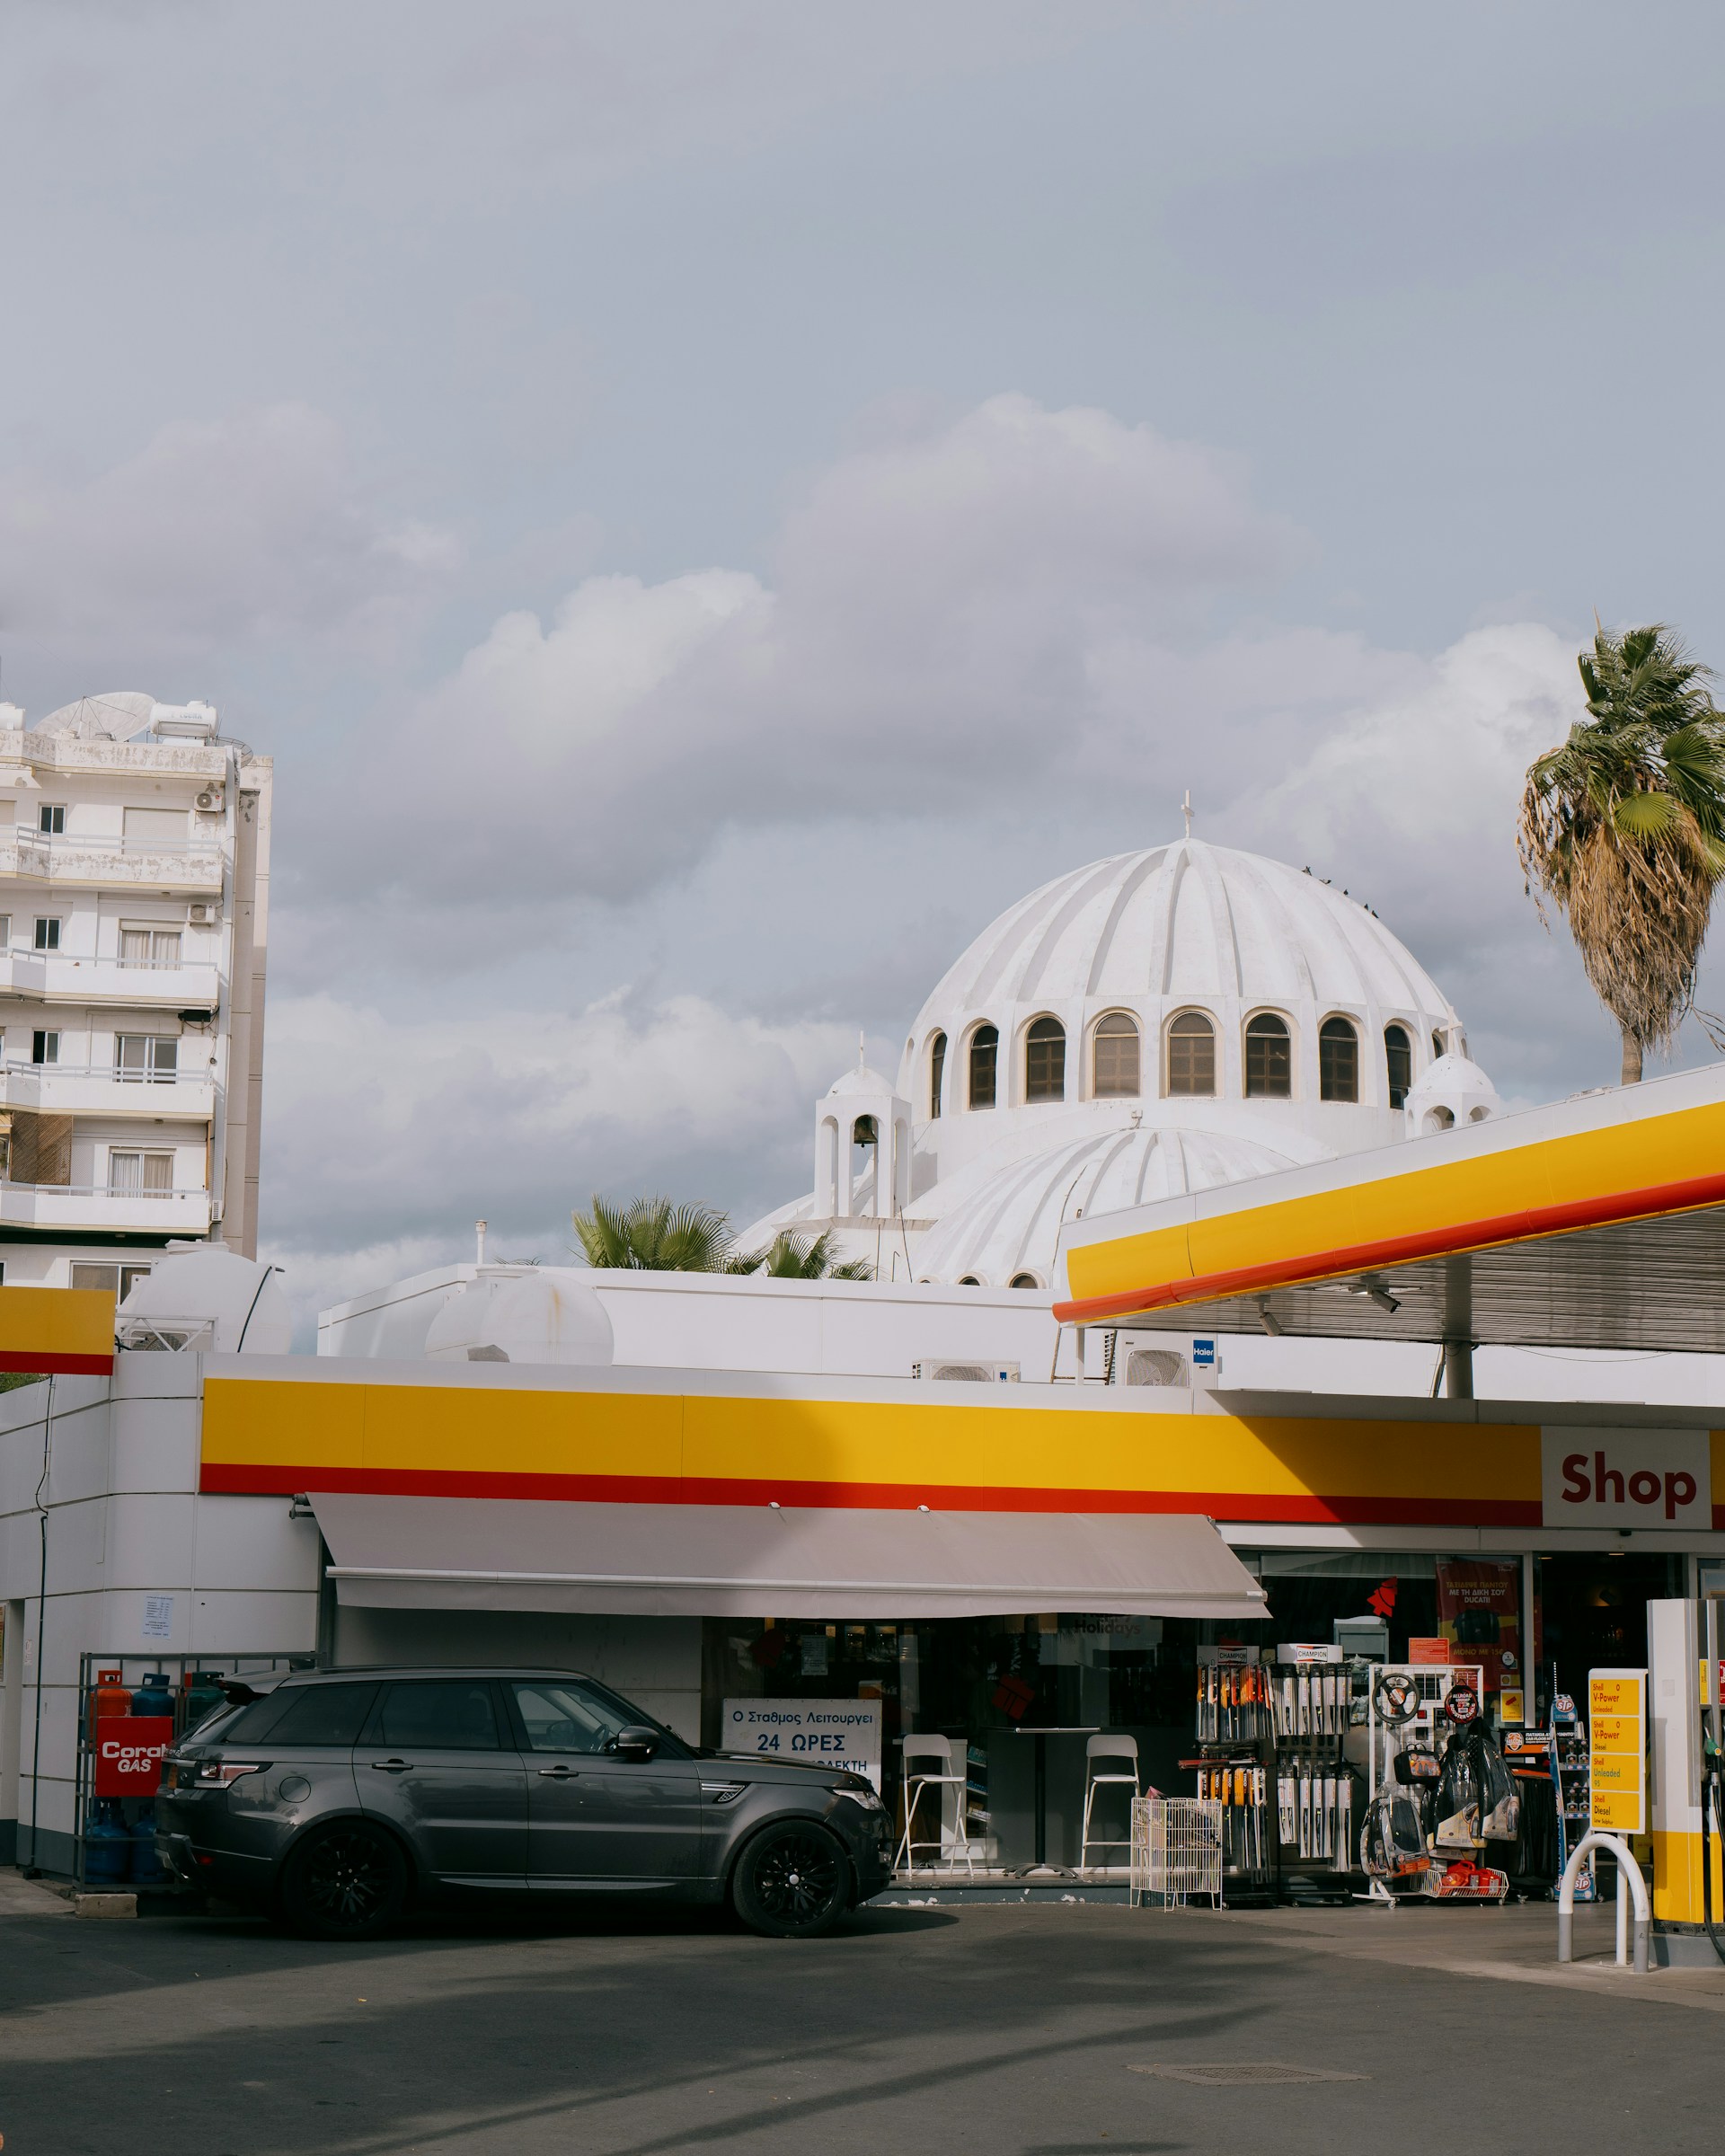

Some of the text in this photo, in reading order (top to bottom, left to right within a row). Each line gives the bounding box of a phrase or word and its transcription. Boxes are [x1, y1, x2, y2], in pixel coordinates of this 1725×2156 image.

[1193, 1348, 1213, 1356] Haier
[1561, 1451, 1697, 1520] Shop
[1075, 1619, 1141, 1639] Holidays
[1593, 1692, 1619, 1702] V-Power
[1558, 1700, 1572, 1710] STP
[733, 1710, 872, 1725] Ο Σταθμος Λειτουργει
[1594, 1730, 1620, 1739] V-Power
[757, 1734, 845, 1751] 24 ΩΡΕΣ
[118, 1759, 152, 1772] GAS
[1594, 1769, 1620, 1778] Unleaded
[1595, 1806, 1611, 1816] Diesel
[1575, 1878, 1588, 1888] STP
